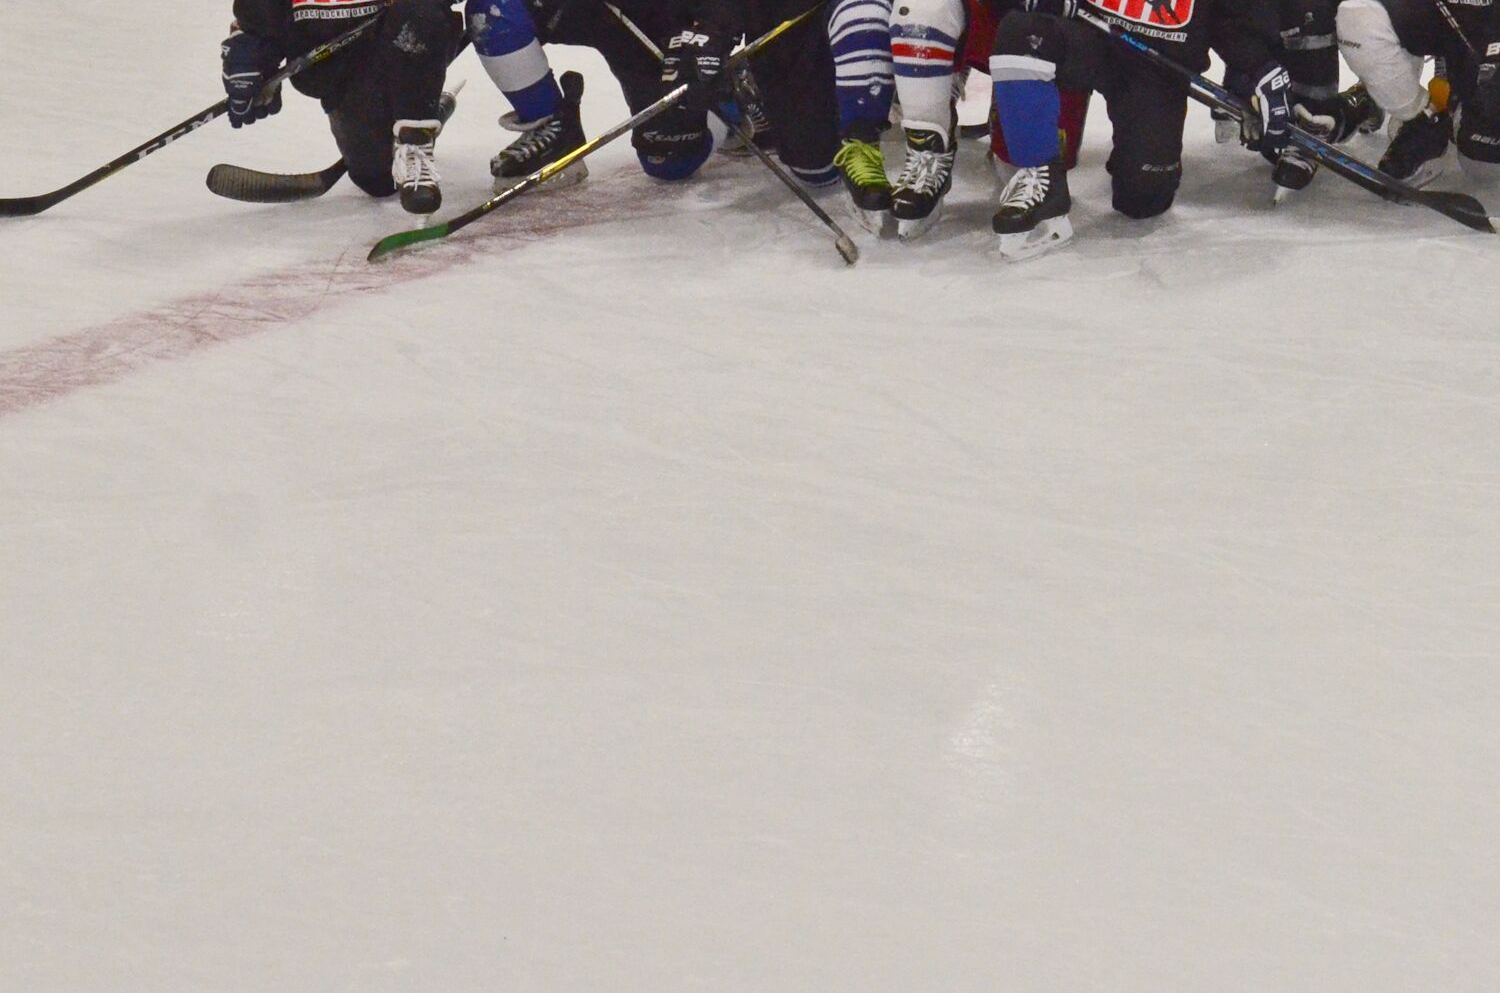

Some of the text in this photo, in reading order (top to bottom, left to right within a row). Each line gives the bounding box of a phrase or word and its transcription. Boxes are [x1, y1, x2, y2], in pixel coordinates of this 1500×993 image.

[294, 8, 320, 22] MPACT
[320, 9, 350, 20] HOCKEY
[1133, 25, 1188, 43] DEVELOPMENT
